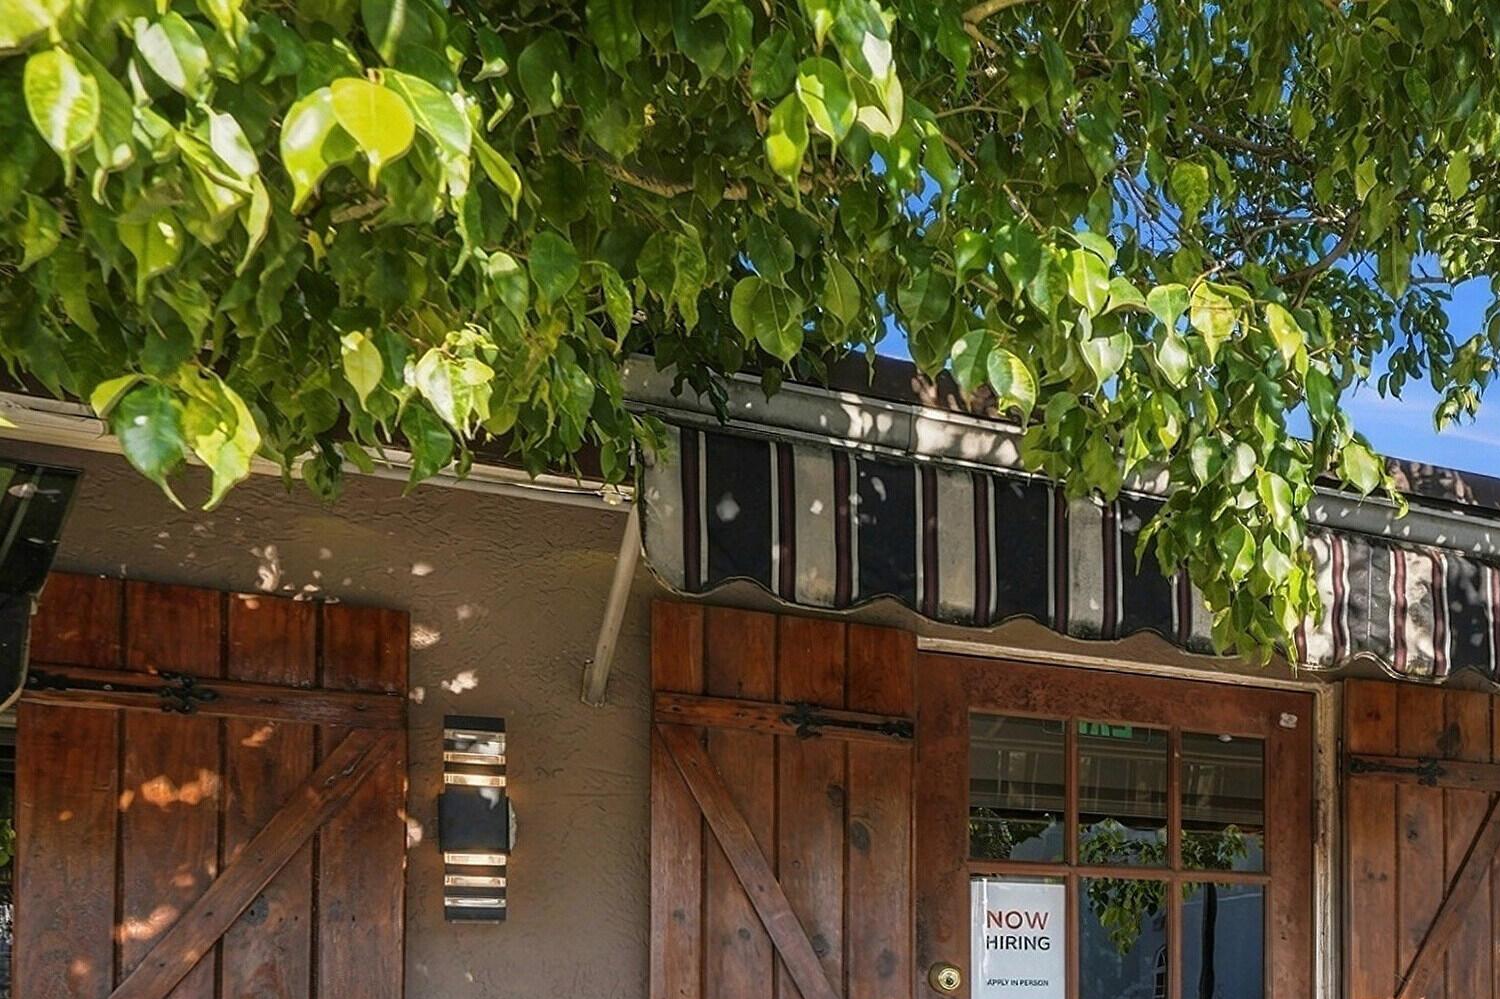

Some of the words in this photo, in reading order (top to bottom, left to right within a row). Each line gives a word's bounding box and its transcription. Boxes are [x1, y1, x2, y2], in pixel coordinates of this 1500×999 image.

[986, 910, 1049, 930] NOW
[986, 935, 1051, 951] HIRING
[987, 979, 1009, 987] APPLY
